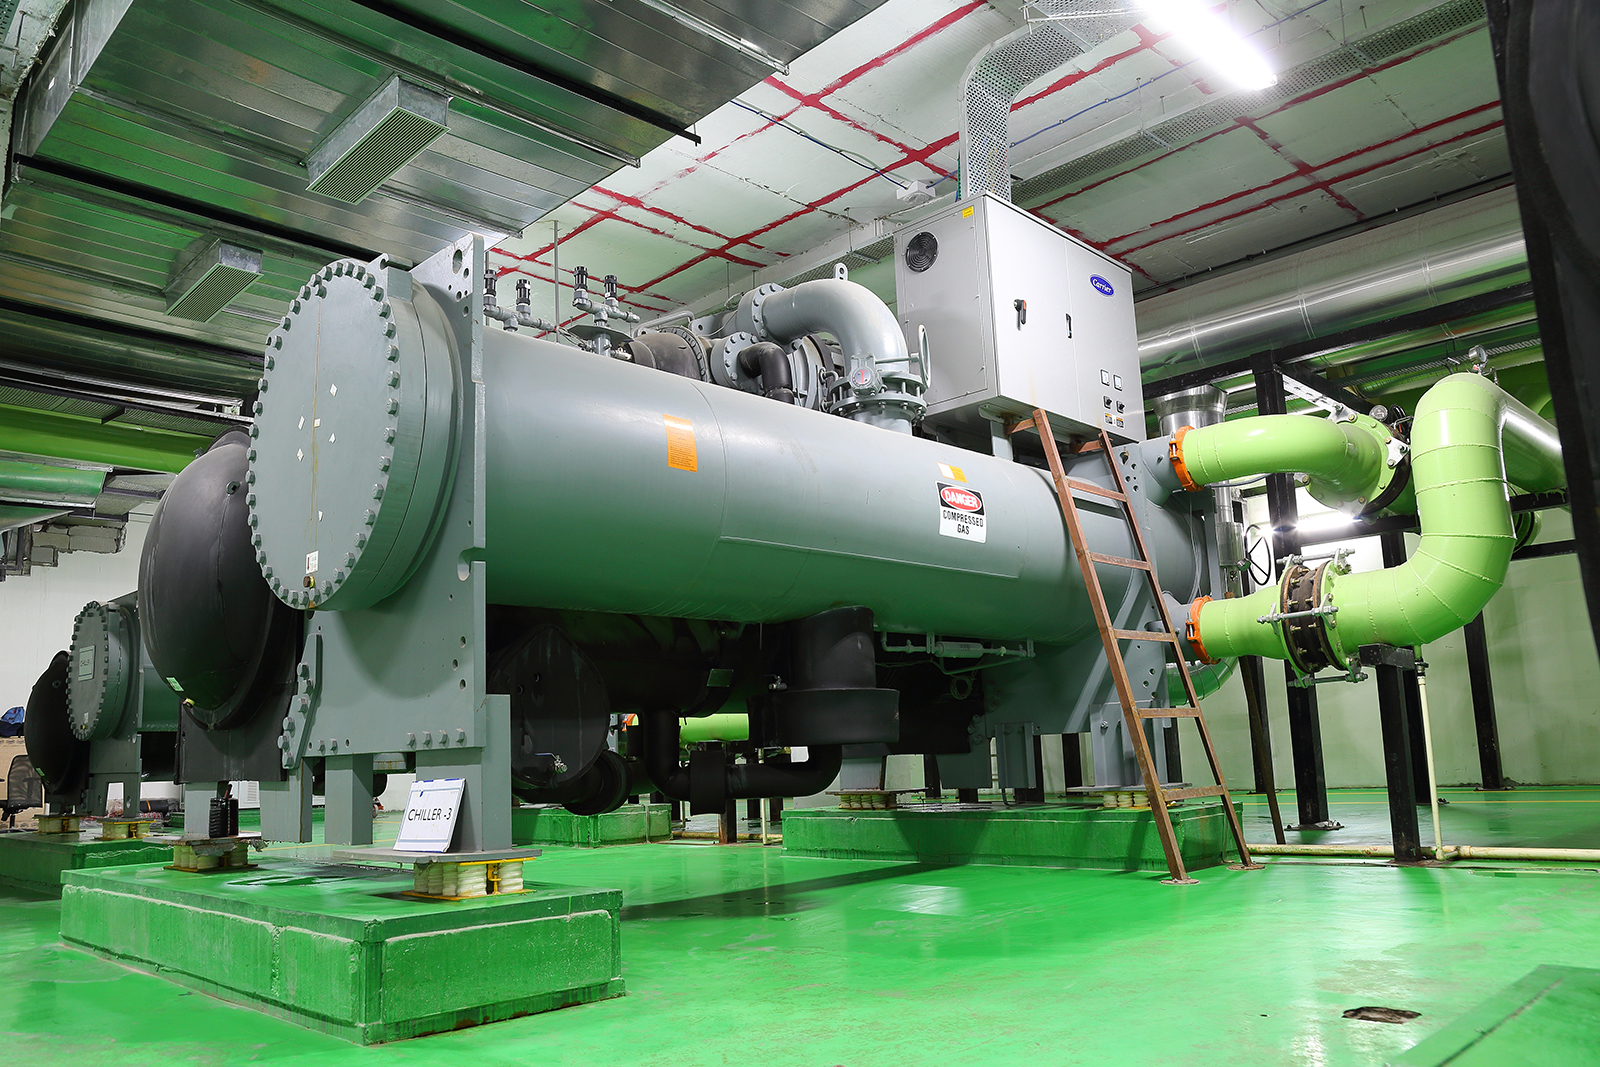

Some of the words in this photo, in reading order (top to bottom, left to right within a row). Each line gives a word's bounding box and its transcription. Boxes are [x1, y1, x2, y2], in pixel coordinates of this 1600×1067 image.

[944, 489, 979, 509] DANGER
[942, 509, 984, 527] COMPRESSED
[957, 523, 970, 535] GAS
[407, 808, 443, 821] CHILLER
